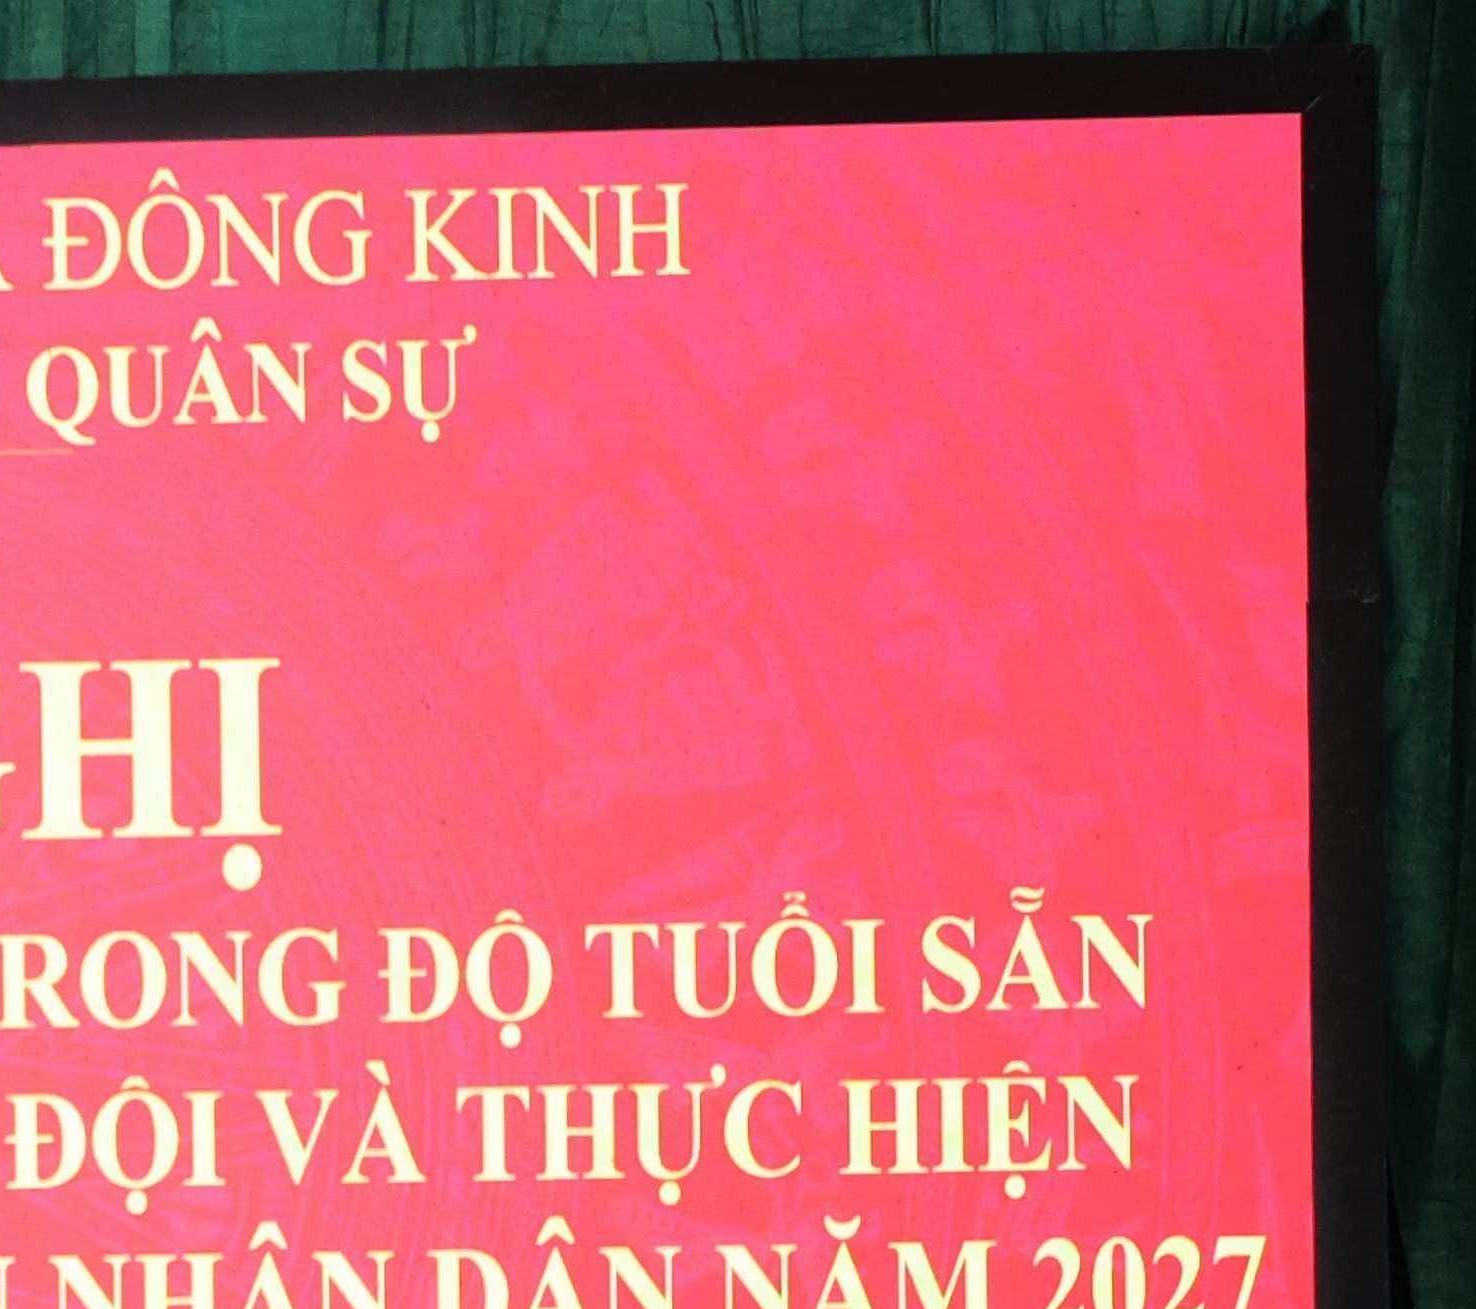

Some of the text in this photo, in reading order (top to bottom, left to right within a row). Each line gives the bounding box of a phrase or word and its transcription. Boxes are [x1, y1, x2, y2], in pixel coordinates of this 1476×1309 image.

[43, 168, 372, 290] ĐÔNG
[406, 184, 690, 281] KINH
[24, 318, 311, 441] QUÂN
[343, 325, 476, 442] SỰ
[379, 910, 552, 1047] ĐỘ
[585, 892, 884, 1017] TUỔI
[922, 887, 1153, 1012] SẴN
[5, 1076, 225, 1214] ĐỘI
[256, 1060, 425, 1184] VÀ
[457, 1064, 801, 1205] THỰC
[840, 1061, 1138, 1198] HIỆN
